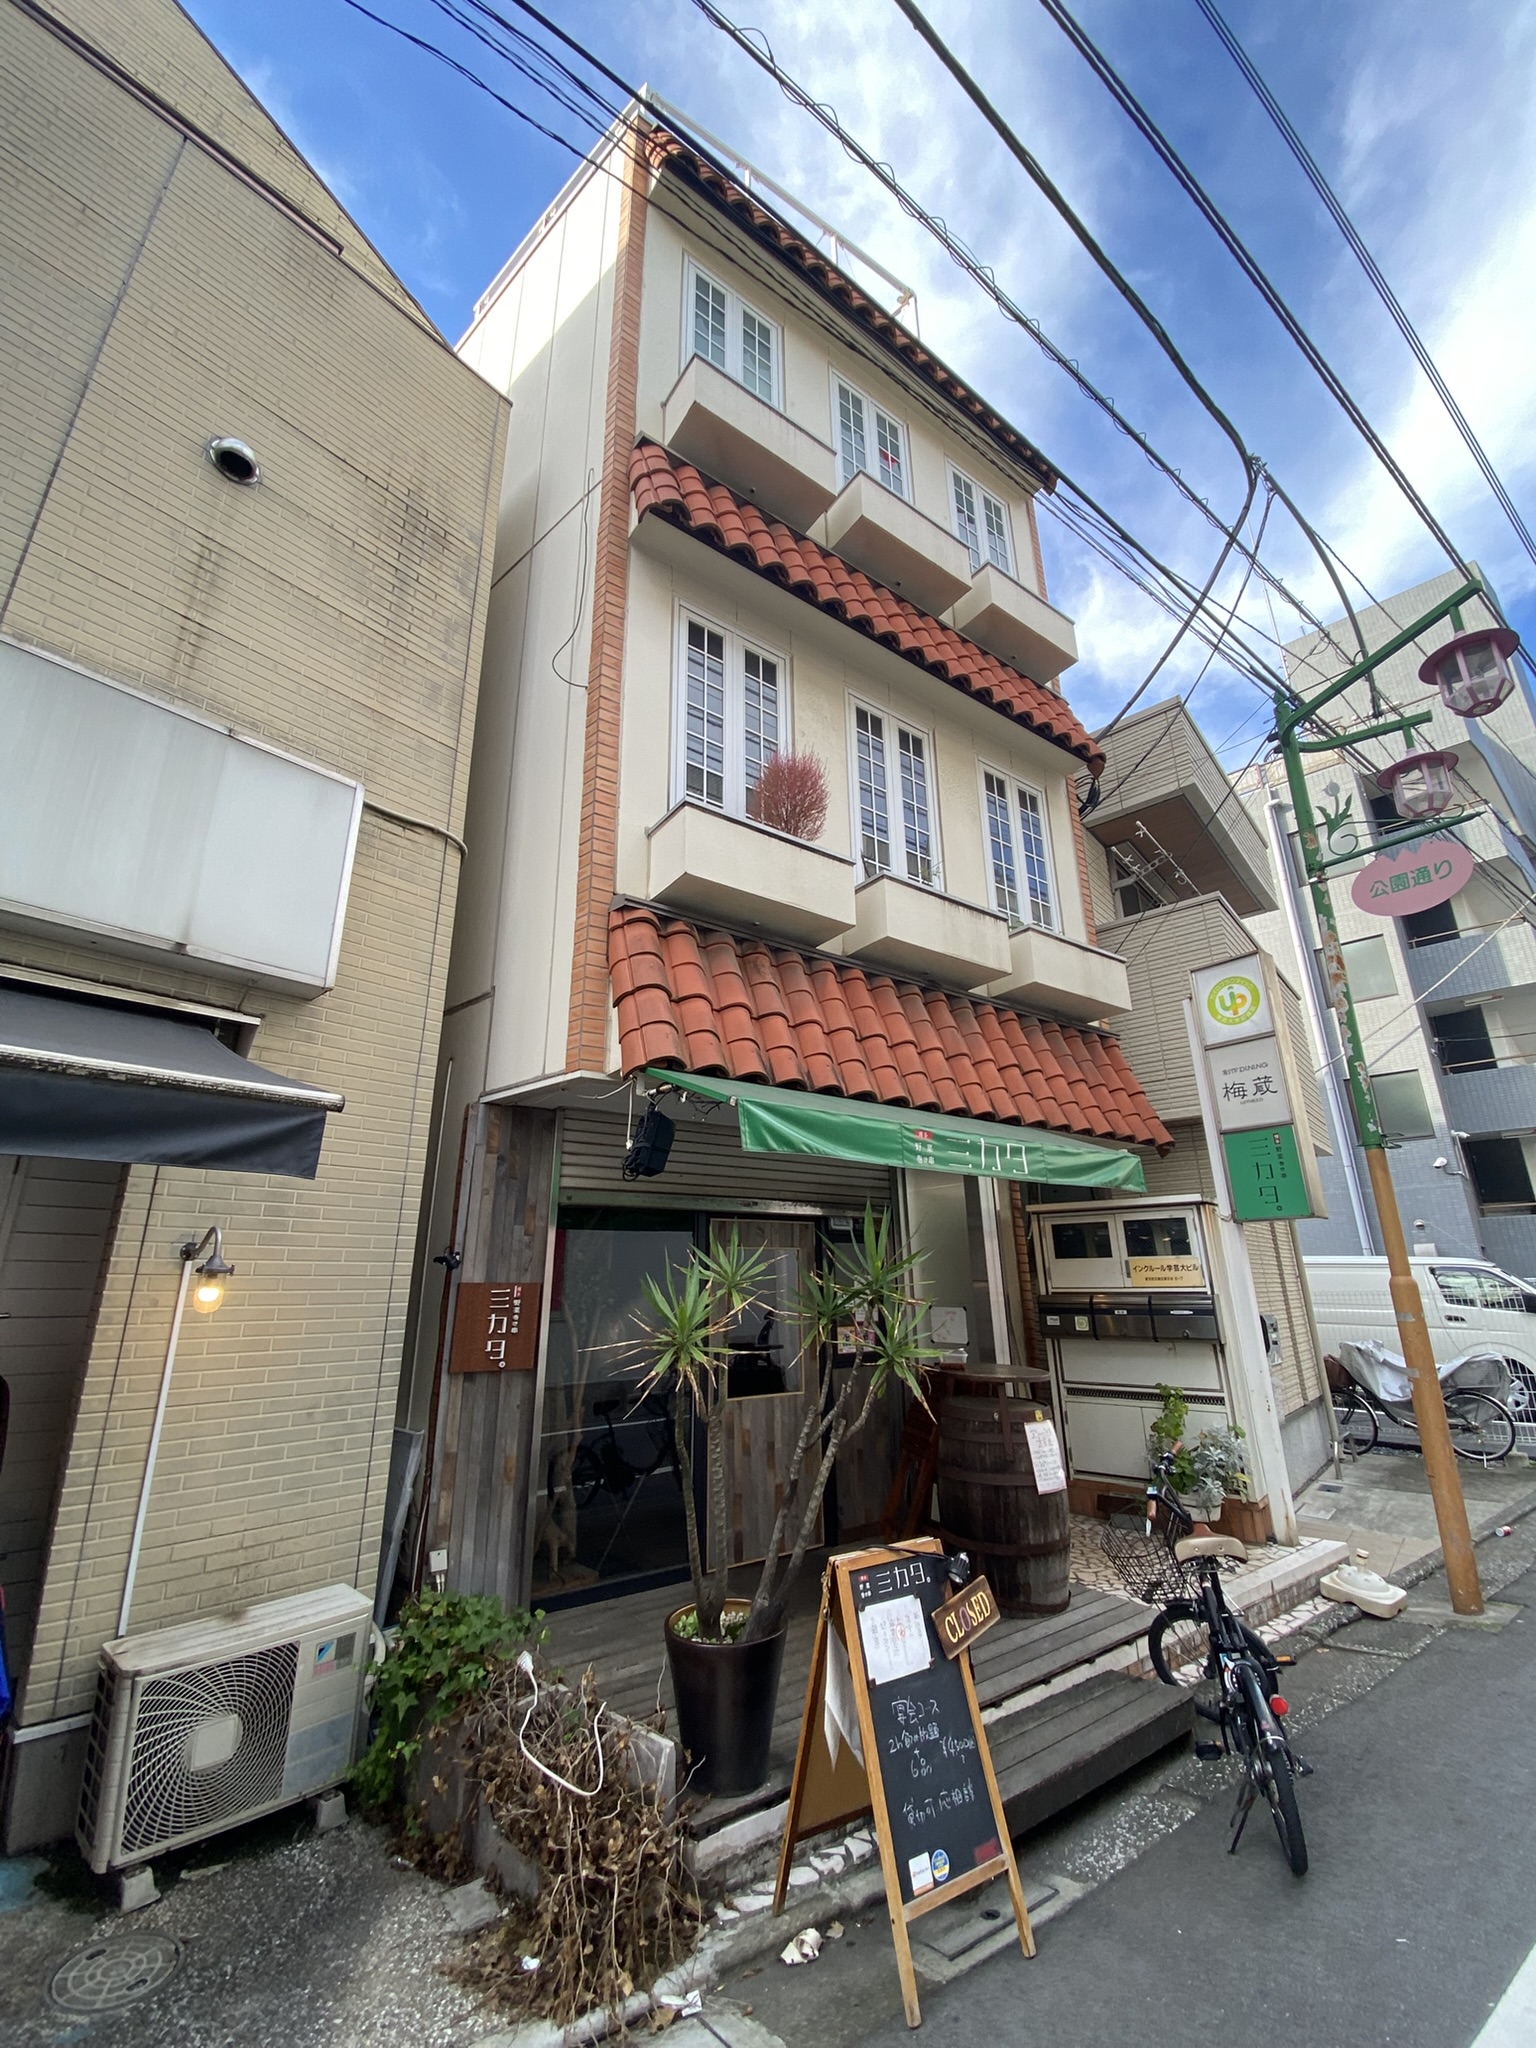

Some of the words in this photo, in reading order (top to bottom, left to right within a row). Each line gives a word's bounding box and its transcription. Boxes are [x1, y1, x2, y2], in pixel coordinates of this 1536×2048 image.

[1369, 860, 1453, 899] 公園通り
[1222, 1075, 1279, 1102] 梅蔵
[1132, 1264, 1199, 1273] インクルール学芸大ビル
[945, 1591, 991, 1644] CLOSED
